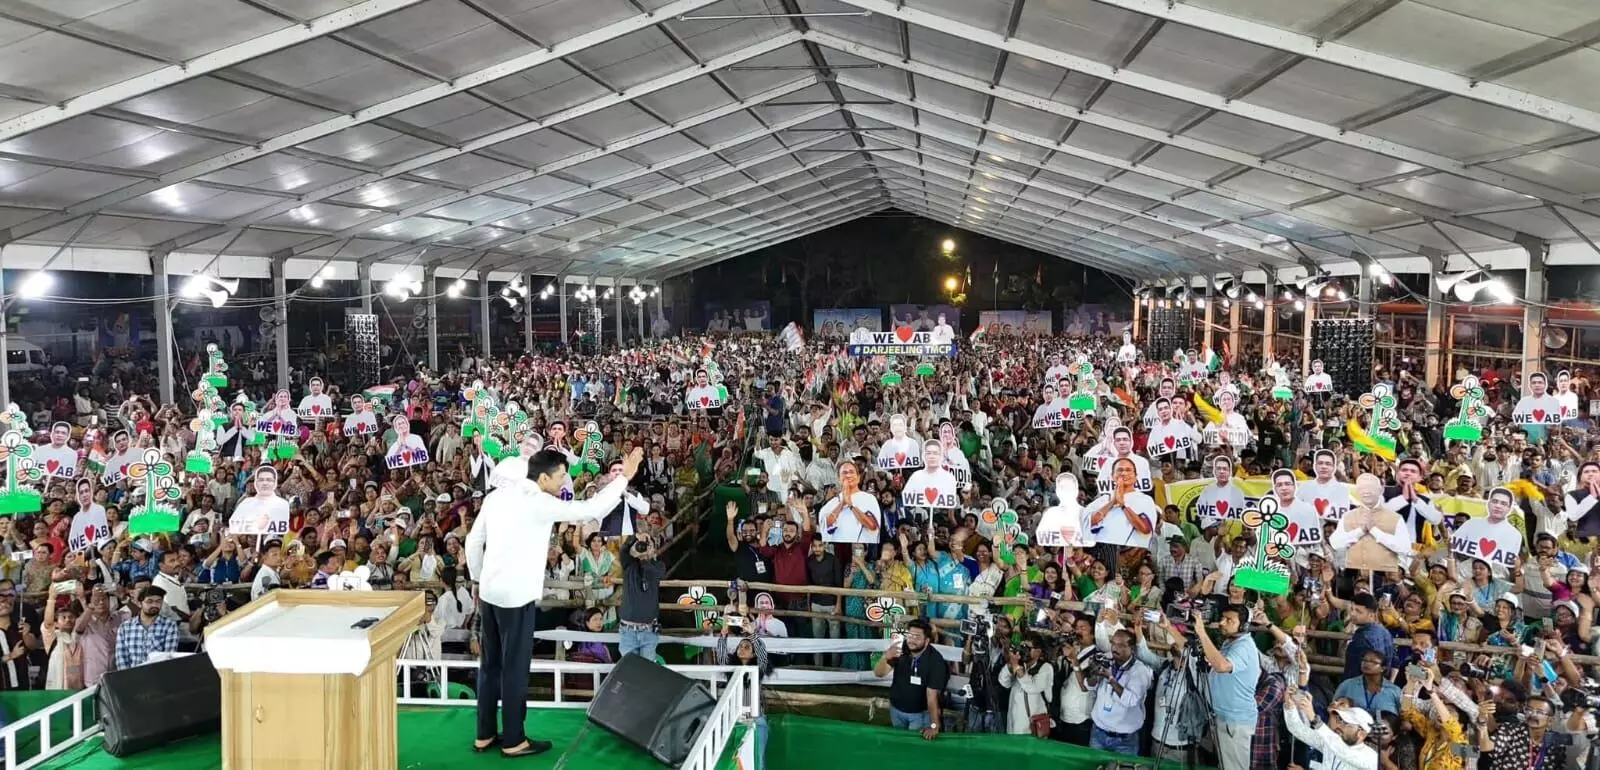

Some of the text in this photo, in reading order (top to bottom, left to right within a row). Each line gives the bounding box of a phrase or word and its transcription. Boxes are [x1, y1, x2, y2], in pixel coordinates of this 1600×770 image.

[873, 334, 931, 343] WE AB
[863, 346, 922, 354] DARJEELING
[926, 346, 951, 354] TMCP
[300, 408, 312, 416] WE
[1048, 412, 1061, 420] WE
[1514, 414, 1561, 423] WE AB
[257, 421, 296, 435] WE MB
[365, 424, 377, 432] AB
[1204, 431, 1218, 443] WE
[1149, 437, 1190, 455] WE AB
[387, 450, 427, 467] WE MB
[879, 456, 920, 467] WE AB
[1083, 456, 1097, 470] WE
[56, 466, 73, 476] AB
[104, 471, 121, 485] WE
[904, 493, 955, 506] WE AB
[1198, 504, 1216, 517] WE
[267, 520, 288, 533] AB
[71, 525, 108, 550] WE AB
[1038, 531, 1060, 544] WE
[1299, 527, 1320, 542] AB
[1453, 537, 1516, 565] WE AB
